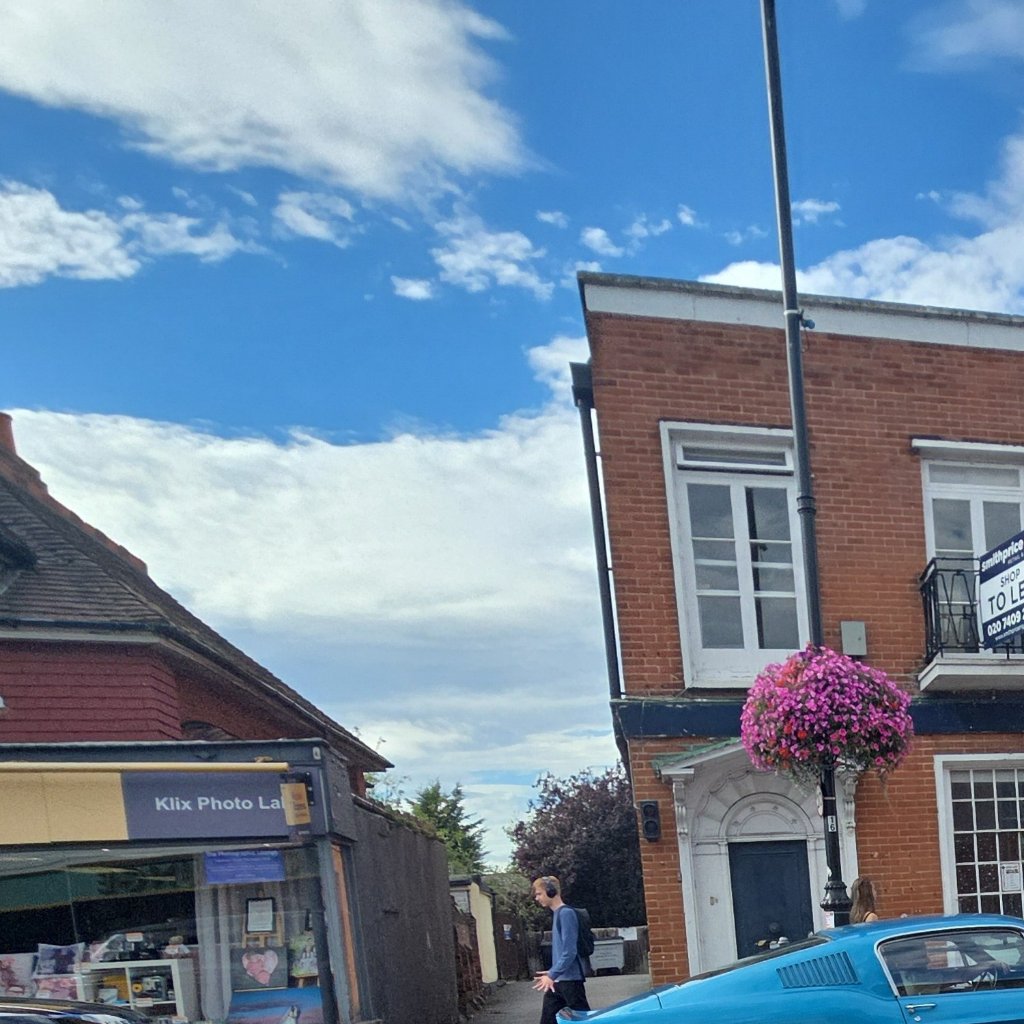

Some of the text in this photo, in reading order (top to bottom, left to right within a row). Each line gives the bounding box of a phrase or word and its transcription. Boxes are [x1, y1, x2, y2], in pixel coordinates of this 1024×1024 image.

[981, 540, 1023, 572] smithprice
[1001, 568, 1021, 588] SHOP
[987, 591, 1006, 615] TO
[987, 620, 1002, 637] 020
[1001, 610, 1021, 630] 7409
[155, 797, 193, 811] Klix
[197, 797, 254, 811] Photo
